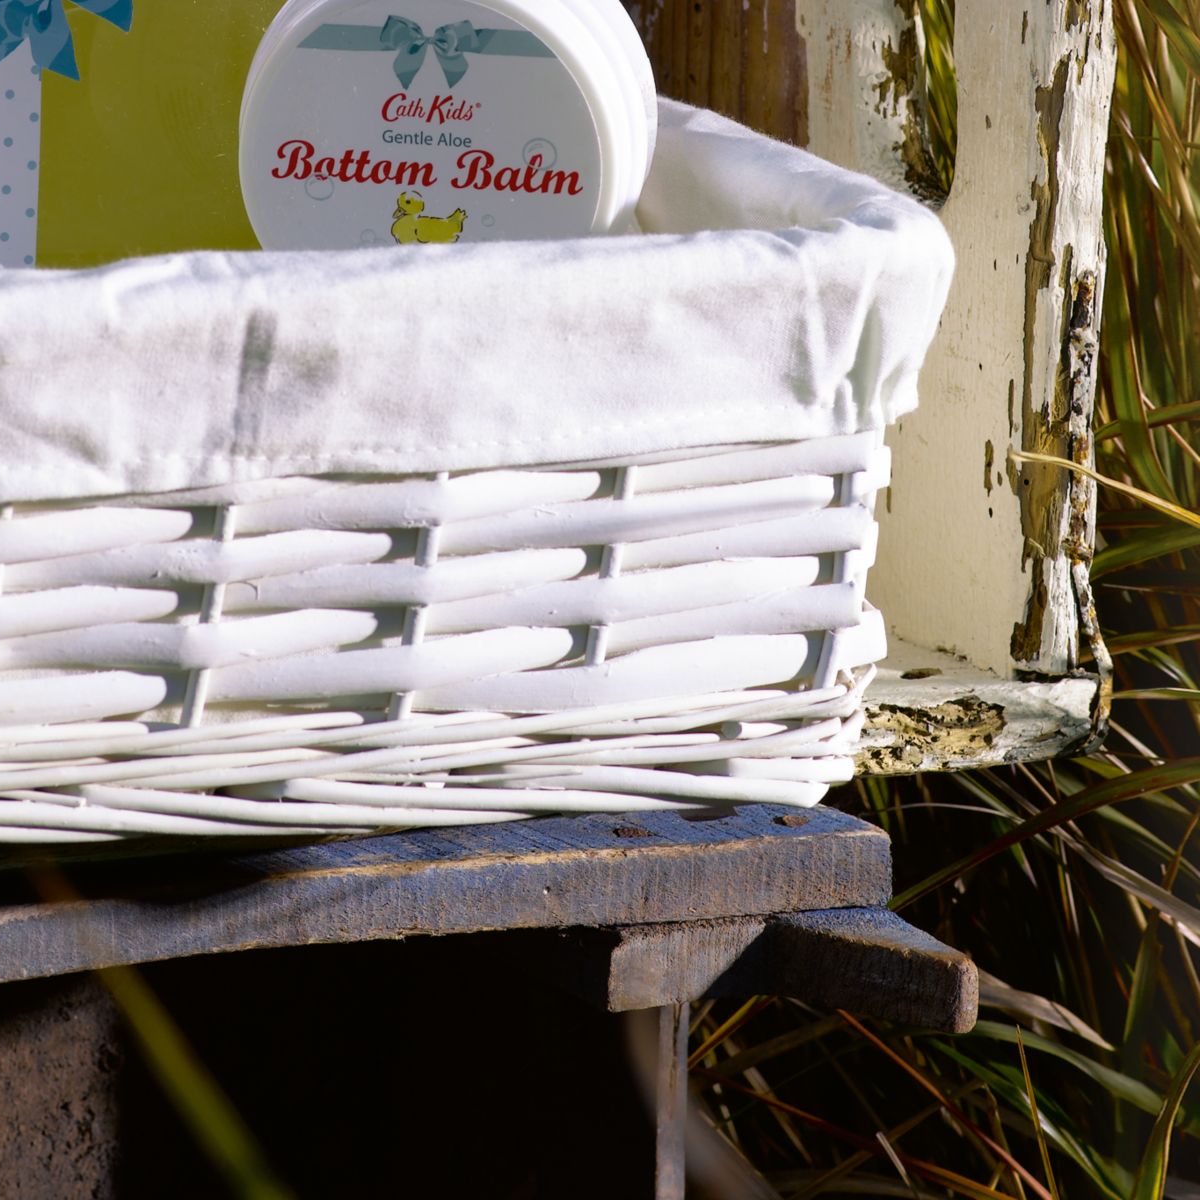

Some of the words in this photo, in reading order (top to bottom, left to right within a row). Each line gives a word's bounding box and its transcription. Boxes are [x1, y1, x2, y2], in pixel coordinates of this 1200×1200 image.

[381, 92, 426, 122] Cath
[382, 129, 433, 146] Gentle
[437, 132, 472, 148] Aloe
[271, 139, 438, 187] Bottom
[450, 149, 584, 196] Balm
